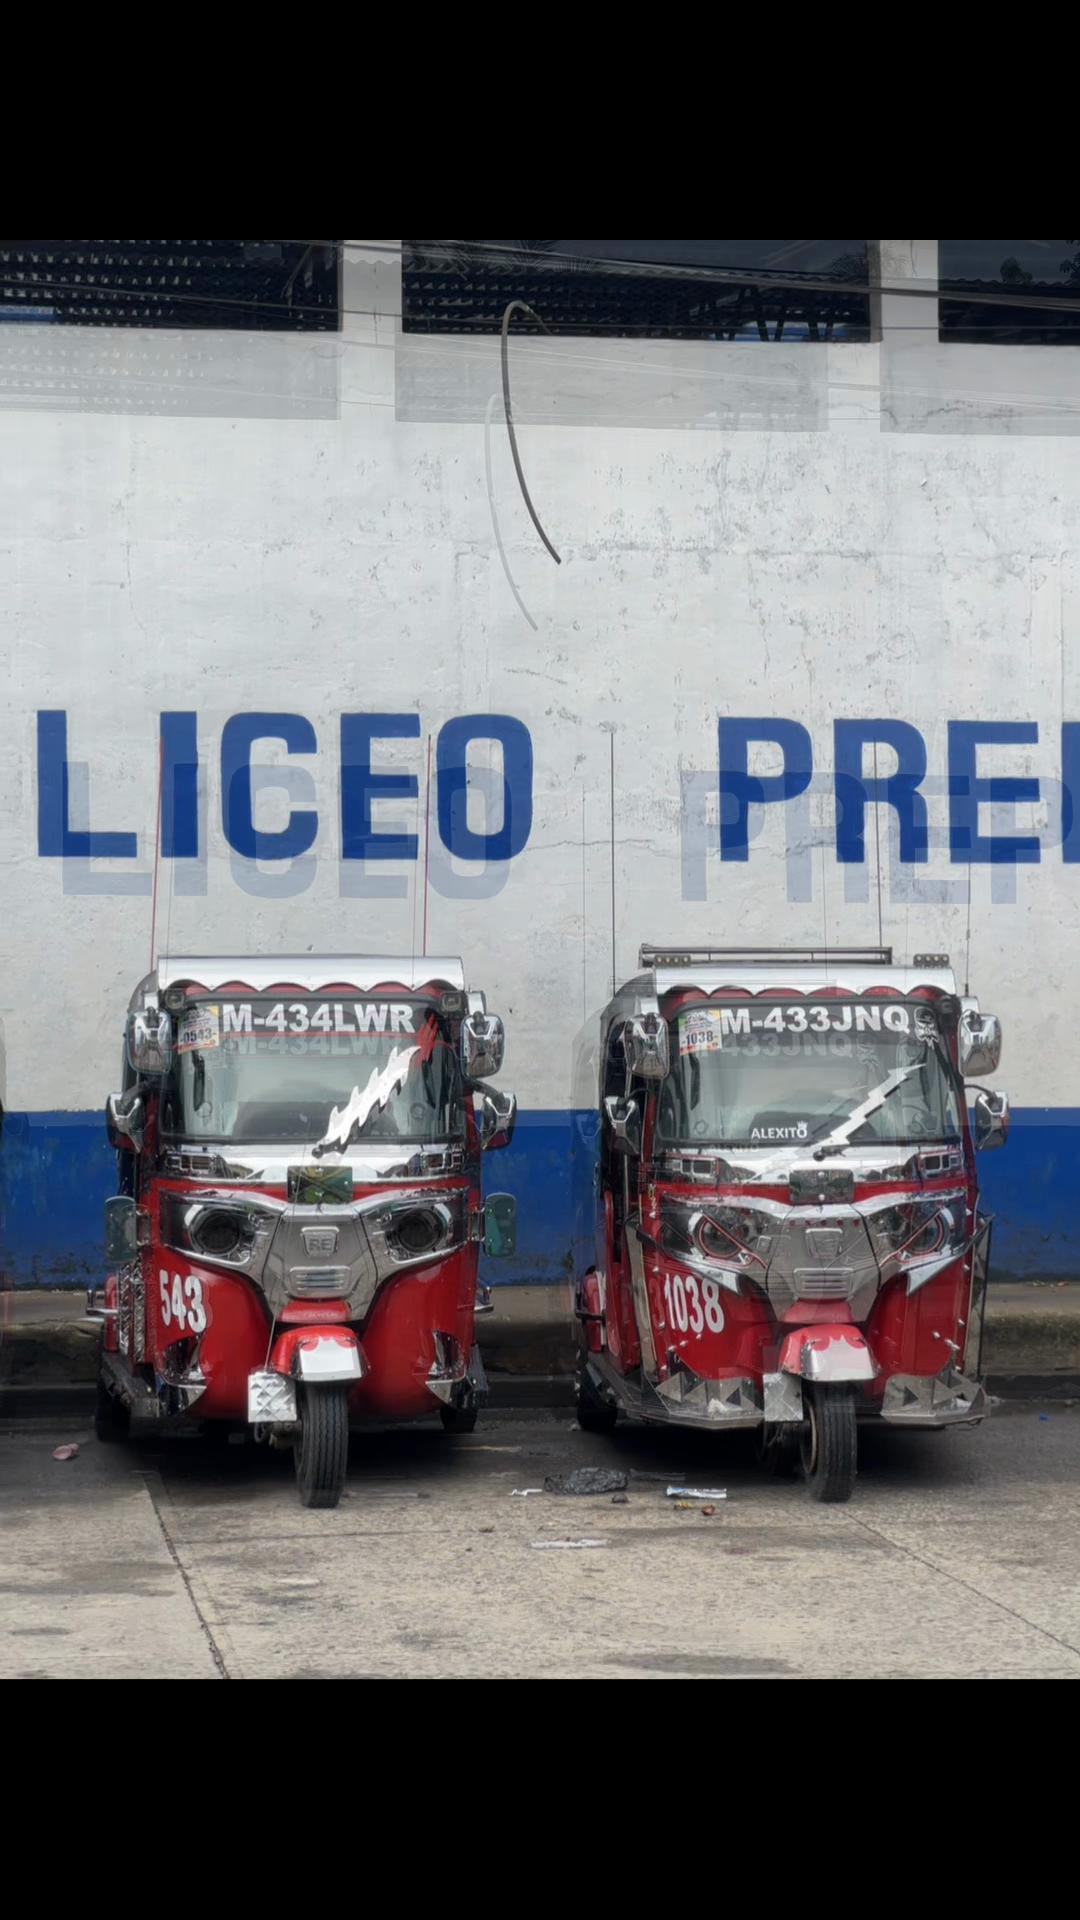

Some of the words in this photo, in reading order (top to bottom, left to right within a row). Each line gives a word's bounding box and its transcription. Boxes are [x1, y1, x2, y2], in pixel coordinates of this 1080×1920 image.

[37, 710, 533, 861] LICEO
[718, 717, 1080, 863] PRE
[223, 1004, 415, 1033] M-434LWR
[720, 1005, 911, 1034] M-433JNQ
[751, 1127, 808, 1139] ALEXITO
[159, 1268, 207, 1334] 543
[664, 1273, 725, 1334] 1038
